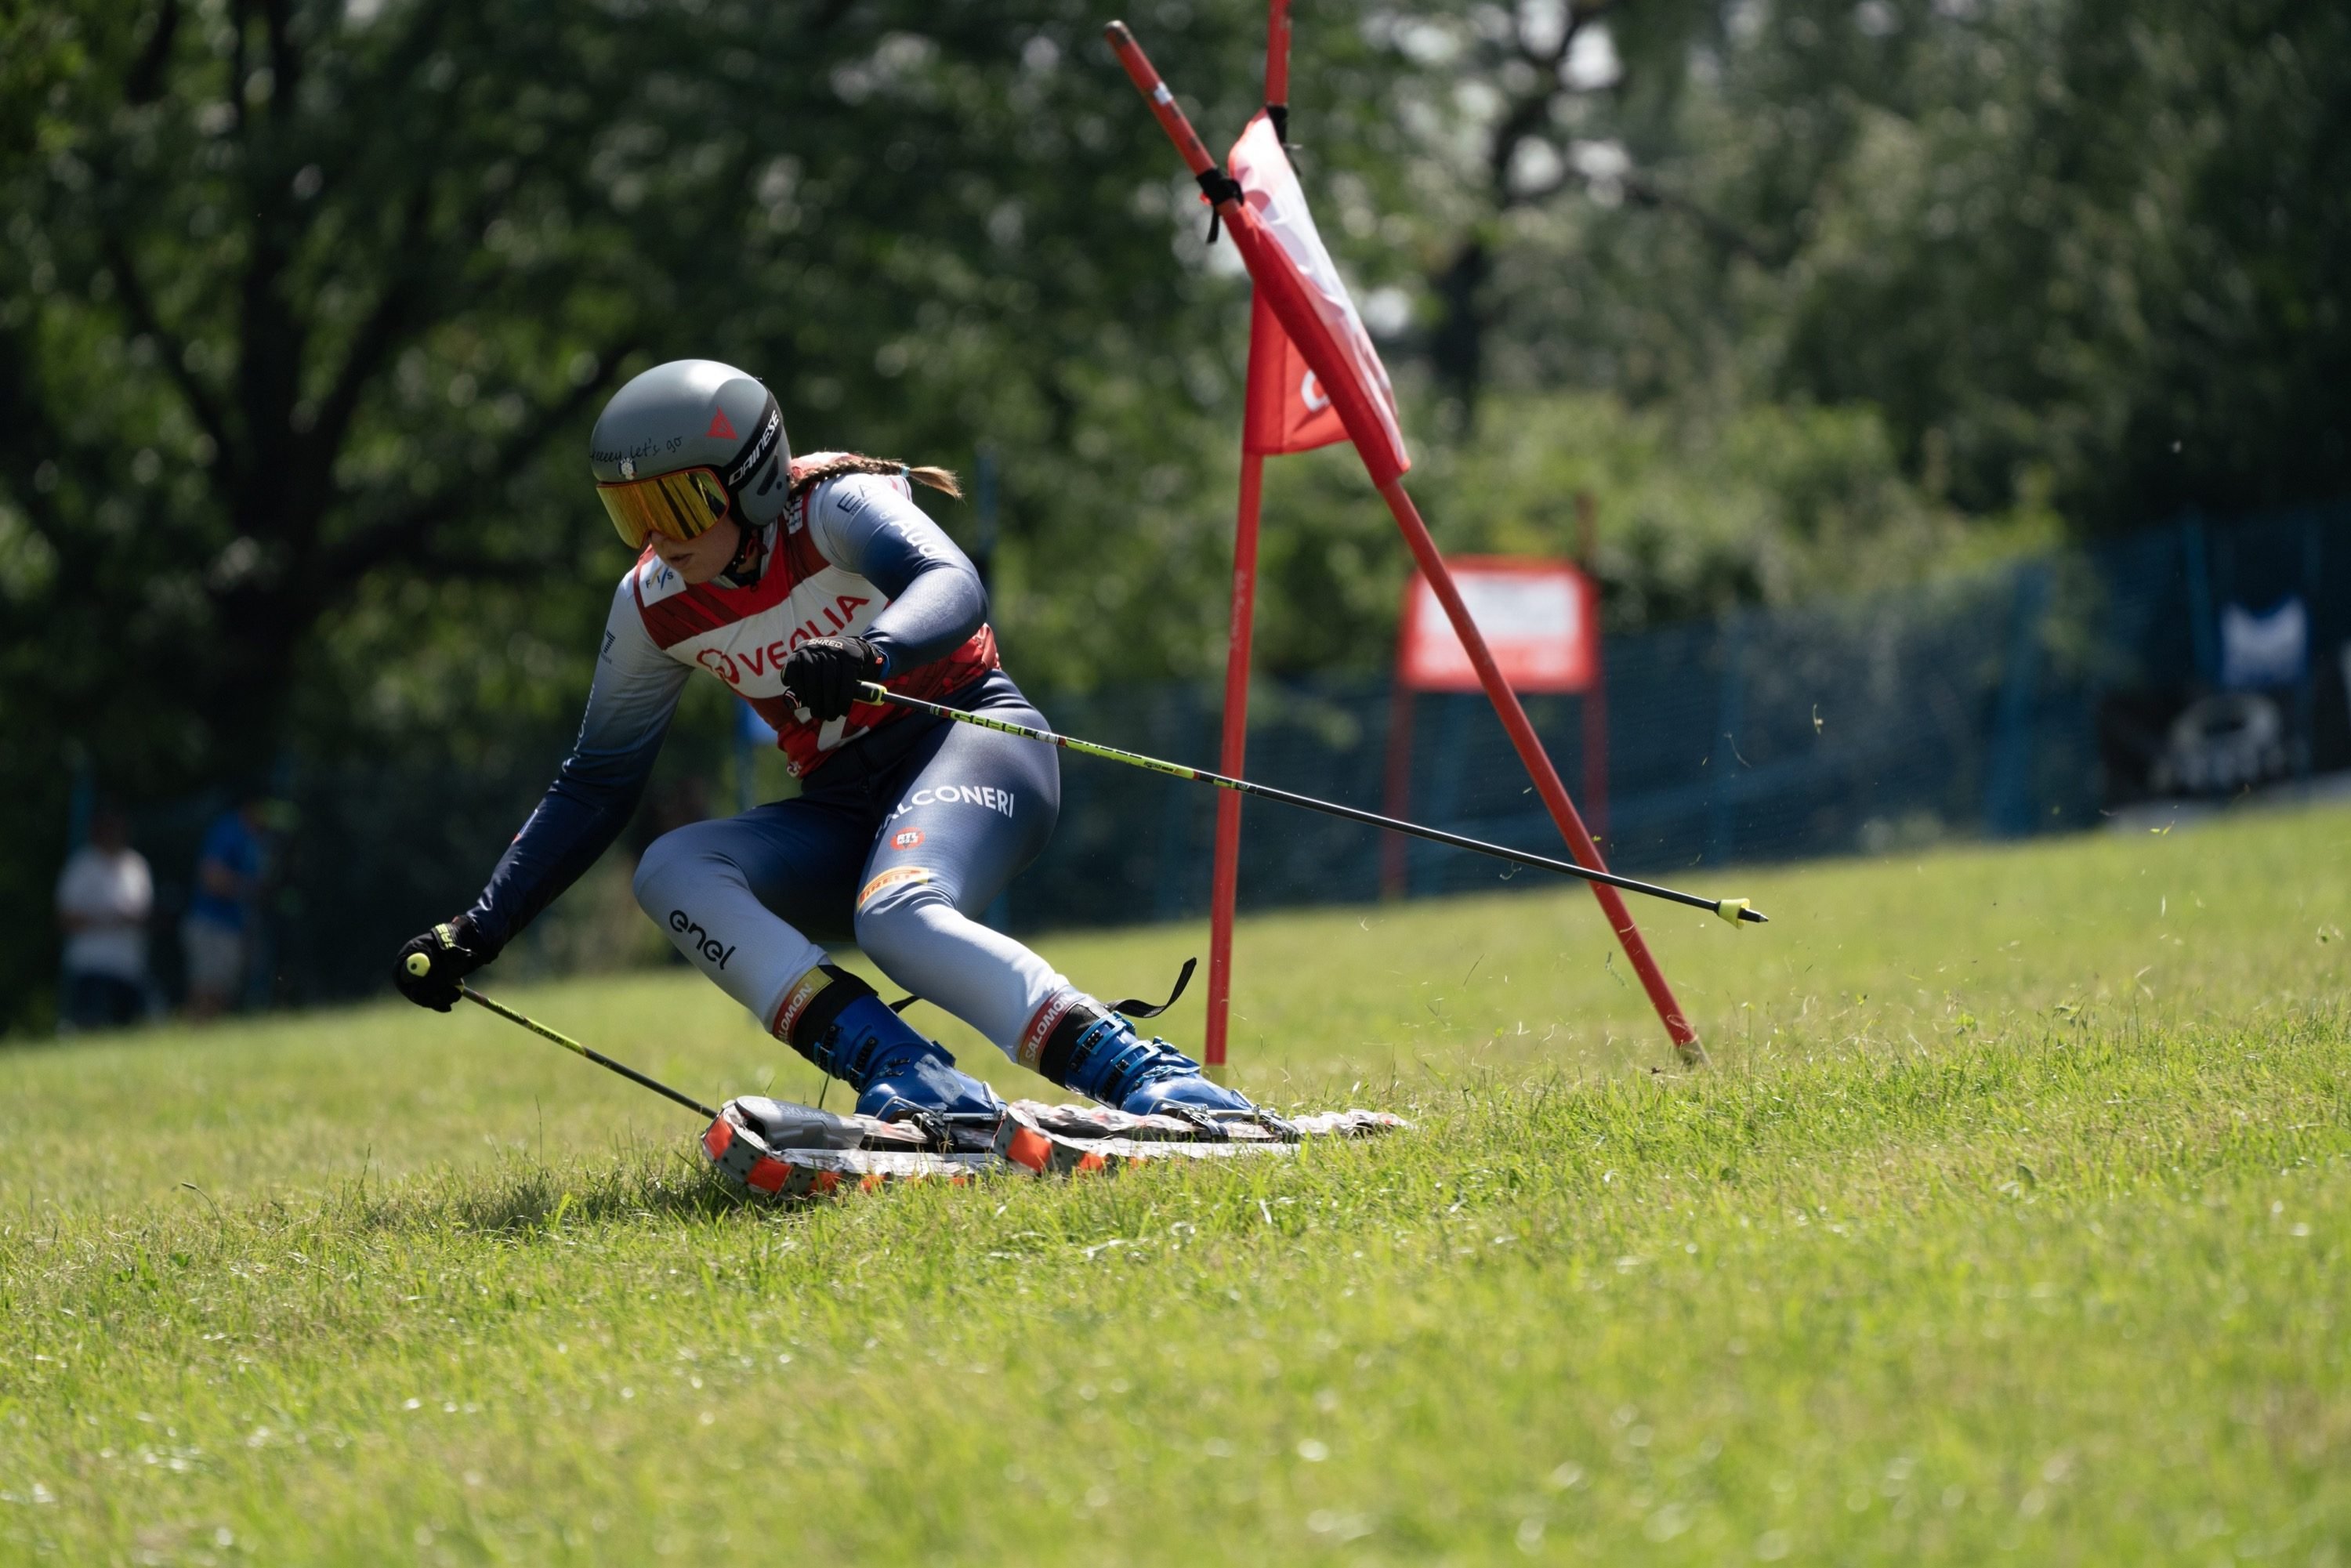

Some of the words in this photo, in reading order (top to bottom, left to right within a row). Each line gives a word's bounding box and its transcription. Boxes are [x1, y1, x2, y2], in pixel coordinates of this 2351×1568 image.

[630, 439, 660, 459] let's
[666, 436, 683, 453] go
[728, 409, 779, 486] DAINESE
[646, 571, 674, 589] FIS
[737, 595, 870, 677] VEOLIA
[950, 711, 1037, 739] GABEL
[669, 910, 736, 970] enel
[778, 983, 812, 1044] ALOMON
[1026, 994, 1071, 1061] SALOMON
